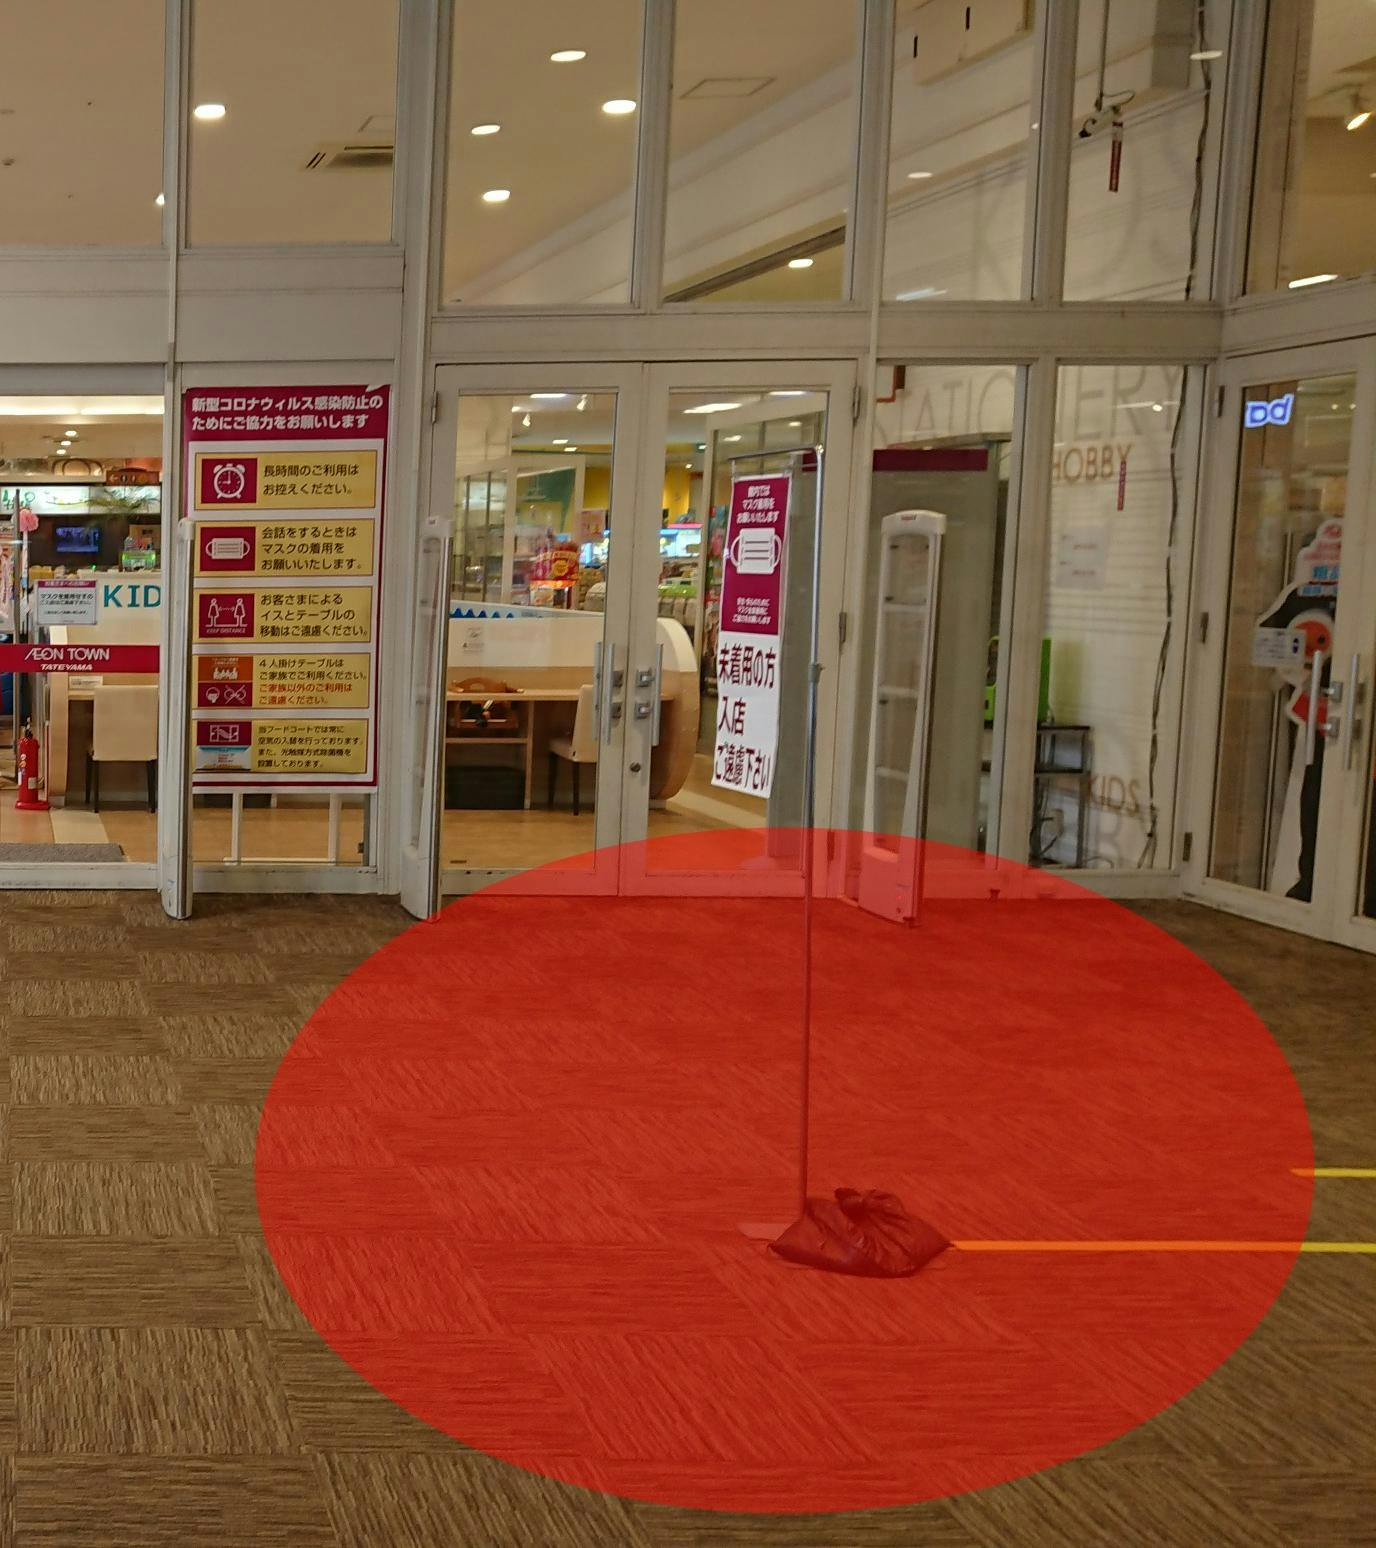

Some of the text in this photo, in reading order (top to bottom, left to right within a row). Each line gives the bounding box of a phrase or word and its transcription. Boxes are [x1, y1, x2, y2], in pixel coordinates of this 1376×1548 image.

[192, 395, 383, 412] 新型コロナウィルス感染防止の
[192, 414, 368, 430] ためにご協力をお願いします
[264, 464, 359, 477] 長時間のご利用は
[263, 483, 352, 496] お控えください。
[262, 527, 356, 538] 会話をするときは
[262, 542, 345, 554] マスクの着用を
[261, 558, 362, 570] お願いいたします。
[104, 585, 161, 608] KID
[260, 594, 343, 606] お客さまによる
[260, 609, 355, 621] イスとテーブルの
[260, 625, 368, 637] 移動はご遠慮ください。
[67, 648, 110, 661] TOWN
[719, 643, 776, 688] 未着用の方
[718, 696, 746, 736] 入店
[715, 741, 772, 790] ご遠慮下さい
